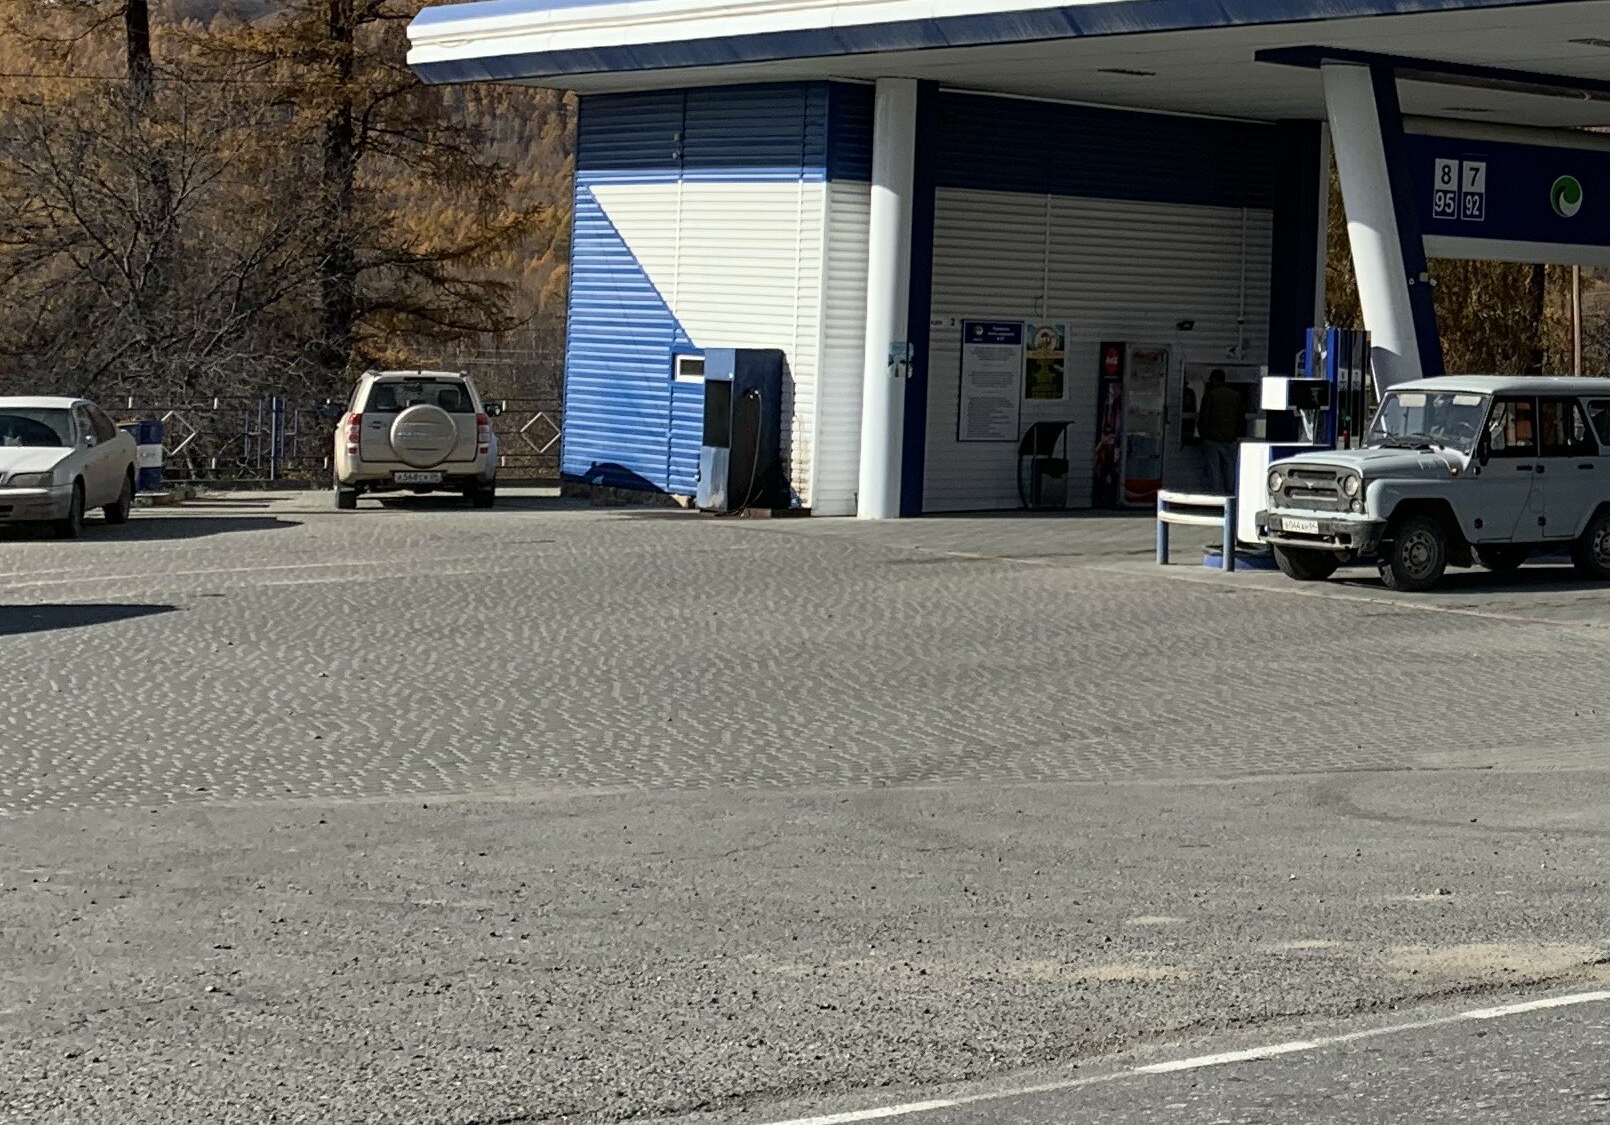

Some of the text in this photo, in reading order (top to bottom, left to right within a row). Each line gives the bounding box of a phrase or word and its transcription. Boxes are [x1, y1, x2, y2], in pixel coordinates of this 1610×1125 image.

[1440, 163, 1480, 187] 8 7
[1434, 191, 1480, 216] 95 92
